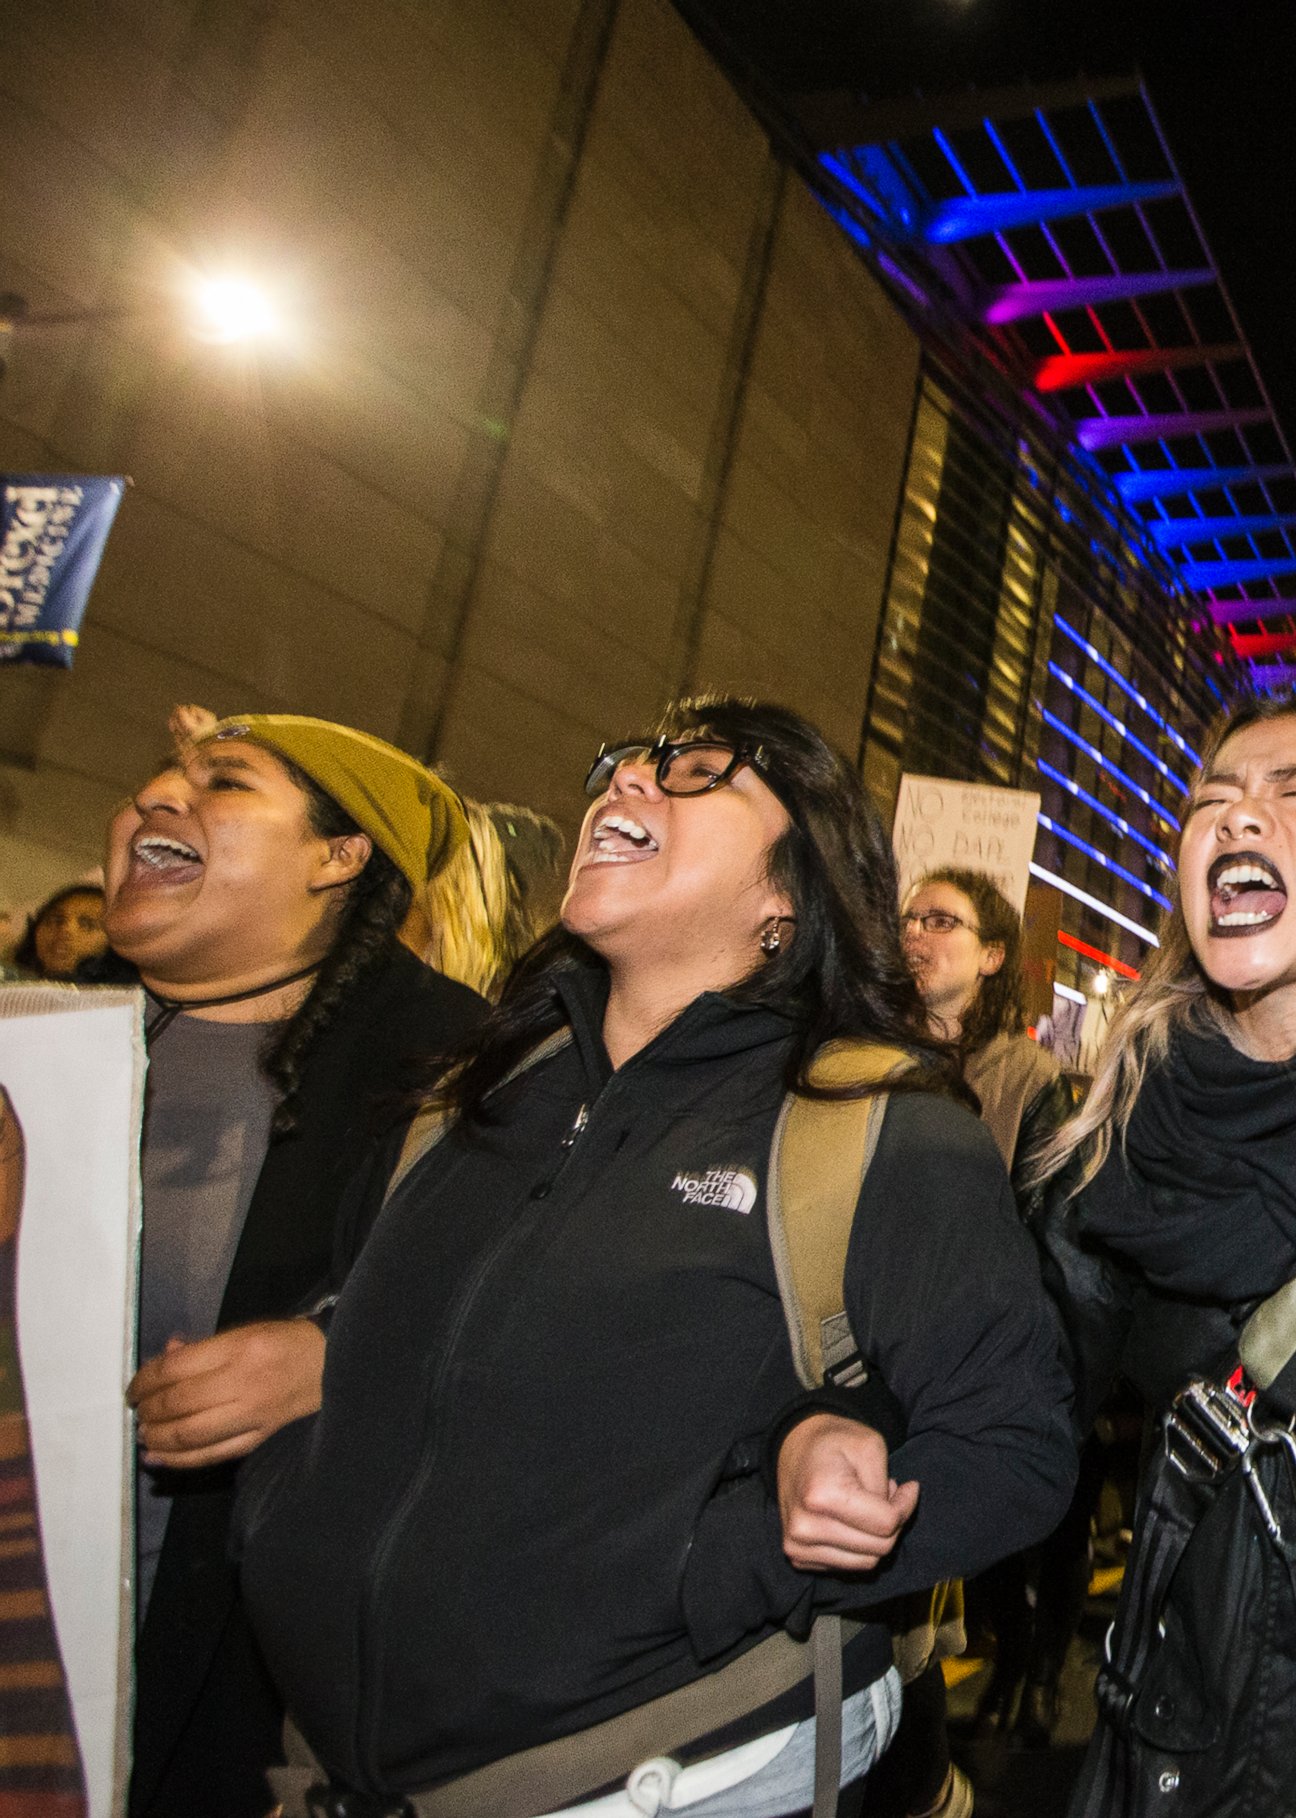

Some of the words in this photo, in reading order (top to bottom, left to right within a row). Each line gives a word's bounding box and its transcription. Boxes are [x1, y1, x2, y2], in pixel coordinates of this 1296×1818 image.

[904, 783, 945, 824] NO
[899, 822, 936, 858] NO
[671, 1175, 732, 1195] NORTH
[703, 1170, 737, 1184] THE
[682, 1191, 725, 1207] FACE
